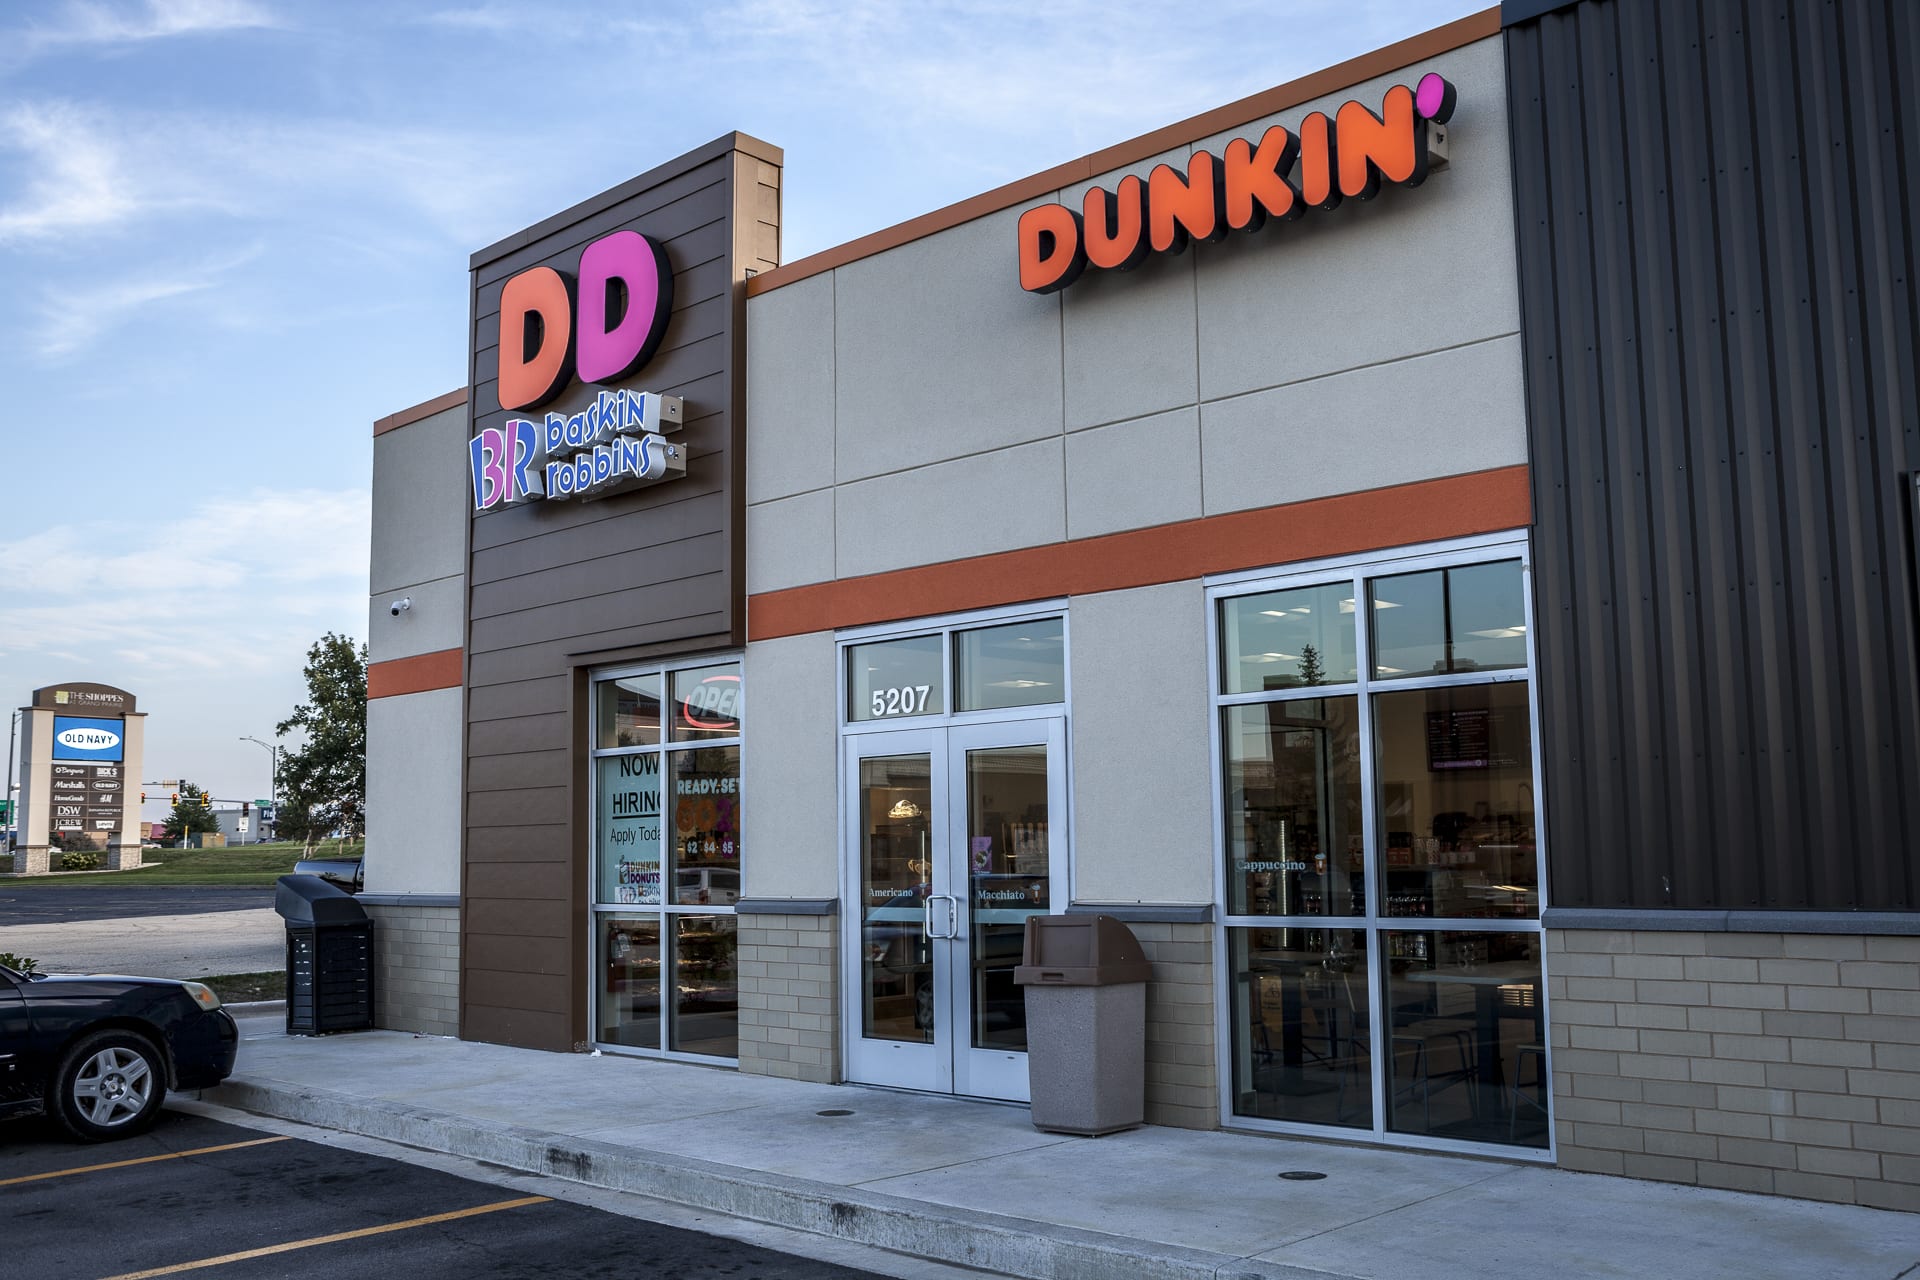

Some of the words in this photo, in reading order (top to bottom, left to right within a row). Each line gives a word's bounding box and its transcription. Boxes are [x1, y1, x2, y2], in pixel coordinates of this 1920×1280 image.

[1018, 73, 1445, 292] DUNKIN'
[469, 418, 538, 511] BR
[69, 691, 85, 700] THE
[85, 692, 124, 702] SHOPPES
[871, 684, 930, 717] 5207
[65, 733, 84, 743] OLD
[86, 734, 113, 744] NAVY
[620, 755, 660, 777] NOW
[57, 805, 81, 815] DSW
[610, 827, 637, 846] Apply
[687, 841, 698, 854] $2
[703, 841, 716, 854] $4
[722, 841, 734, 855] $5
[1235, 858, 1306, 873] Cappuccino
[630, 872, 660, 884] DONUTS
[869, 887, 914, 897] Americano
[978, 889, 1025, 900] Macchiato
